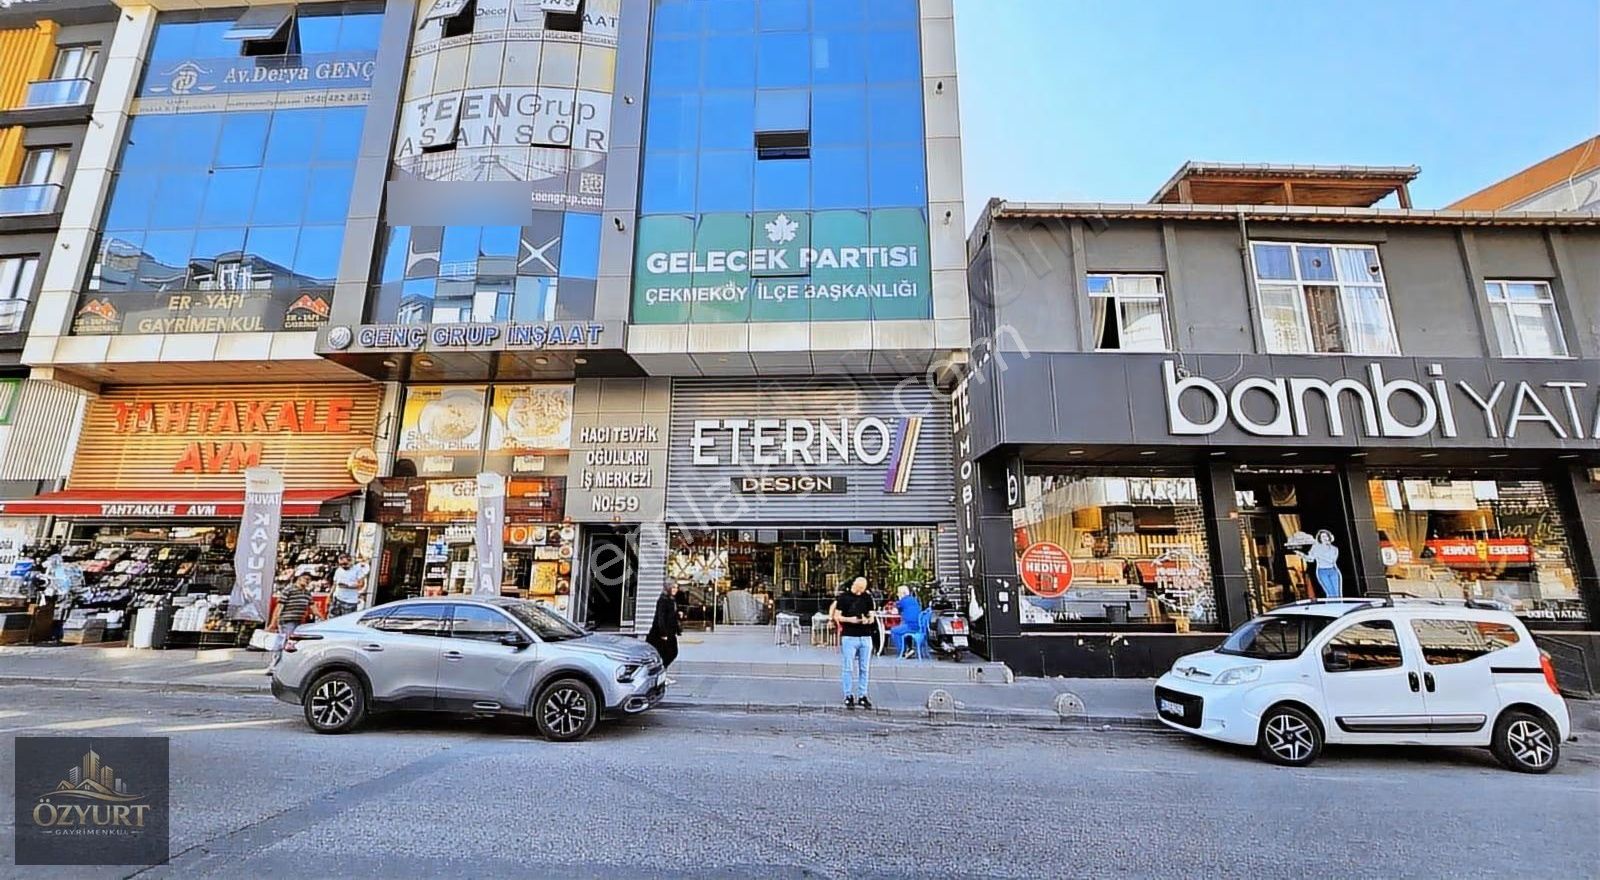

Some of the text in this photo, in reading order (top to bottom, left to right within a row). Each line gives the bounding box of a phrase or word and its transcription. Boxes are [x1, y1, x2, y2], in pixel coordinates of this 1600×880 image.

[316, 61, 375, 82] GENÇ
[418, 92, 596, 127] TEENGrup
[399, 119, 605, 158] ASANSÖR
[646, 245, 917, 274] GELECEK PARTİSİ
[168, 295, 192, 311] ER
[206, 293, 244, 309] YAPI
[646, 279, 917, 306] ÇEKMEKÖY İLÇE BAŞKANLIĞI
[138, 314, 265, 333] GAYRİMENKUL
[358, 319, 604, 350] GENÇ GRUP İNŞAAT
[1161, 359, 1600, 439] bambi YAT
[112, 399, 356, 434] TAHTAKALE
[580, 426, 611, 444] HACI
[613, 422, 659, 444] TEVFİK
[690, 415, 891, 466] ETERNO
[172, 440, 265, 475] AVM
[586, 446, 649, 466] OĞULLARI
[580, 467, 652, 491] İŞ MERKEZİ
[187, 504, 216, 516] AVM
